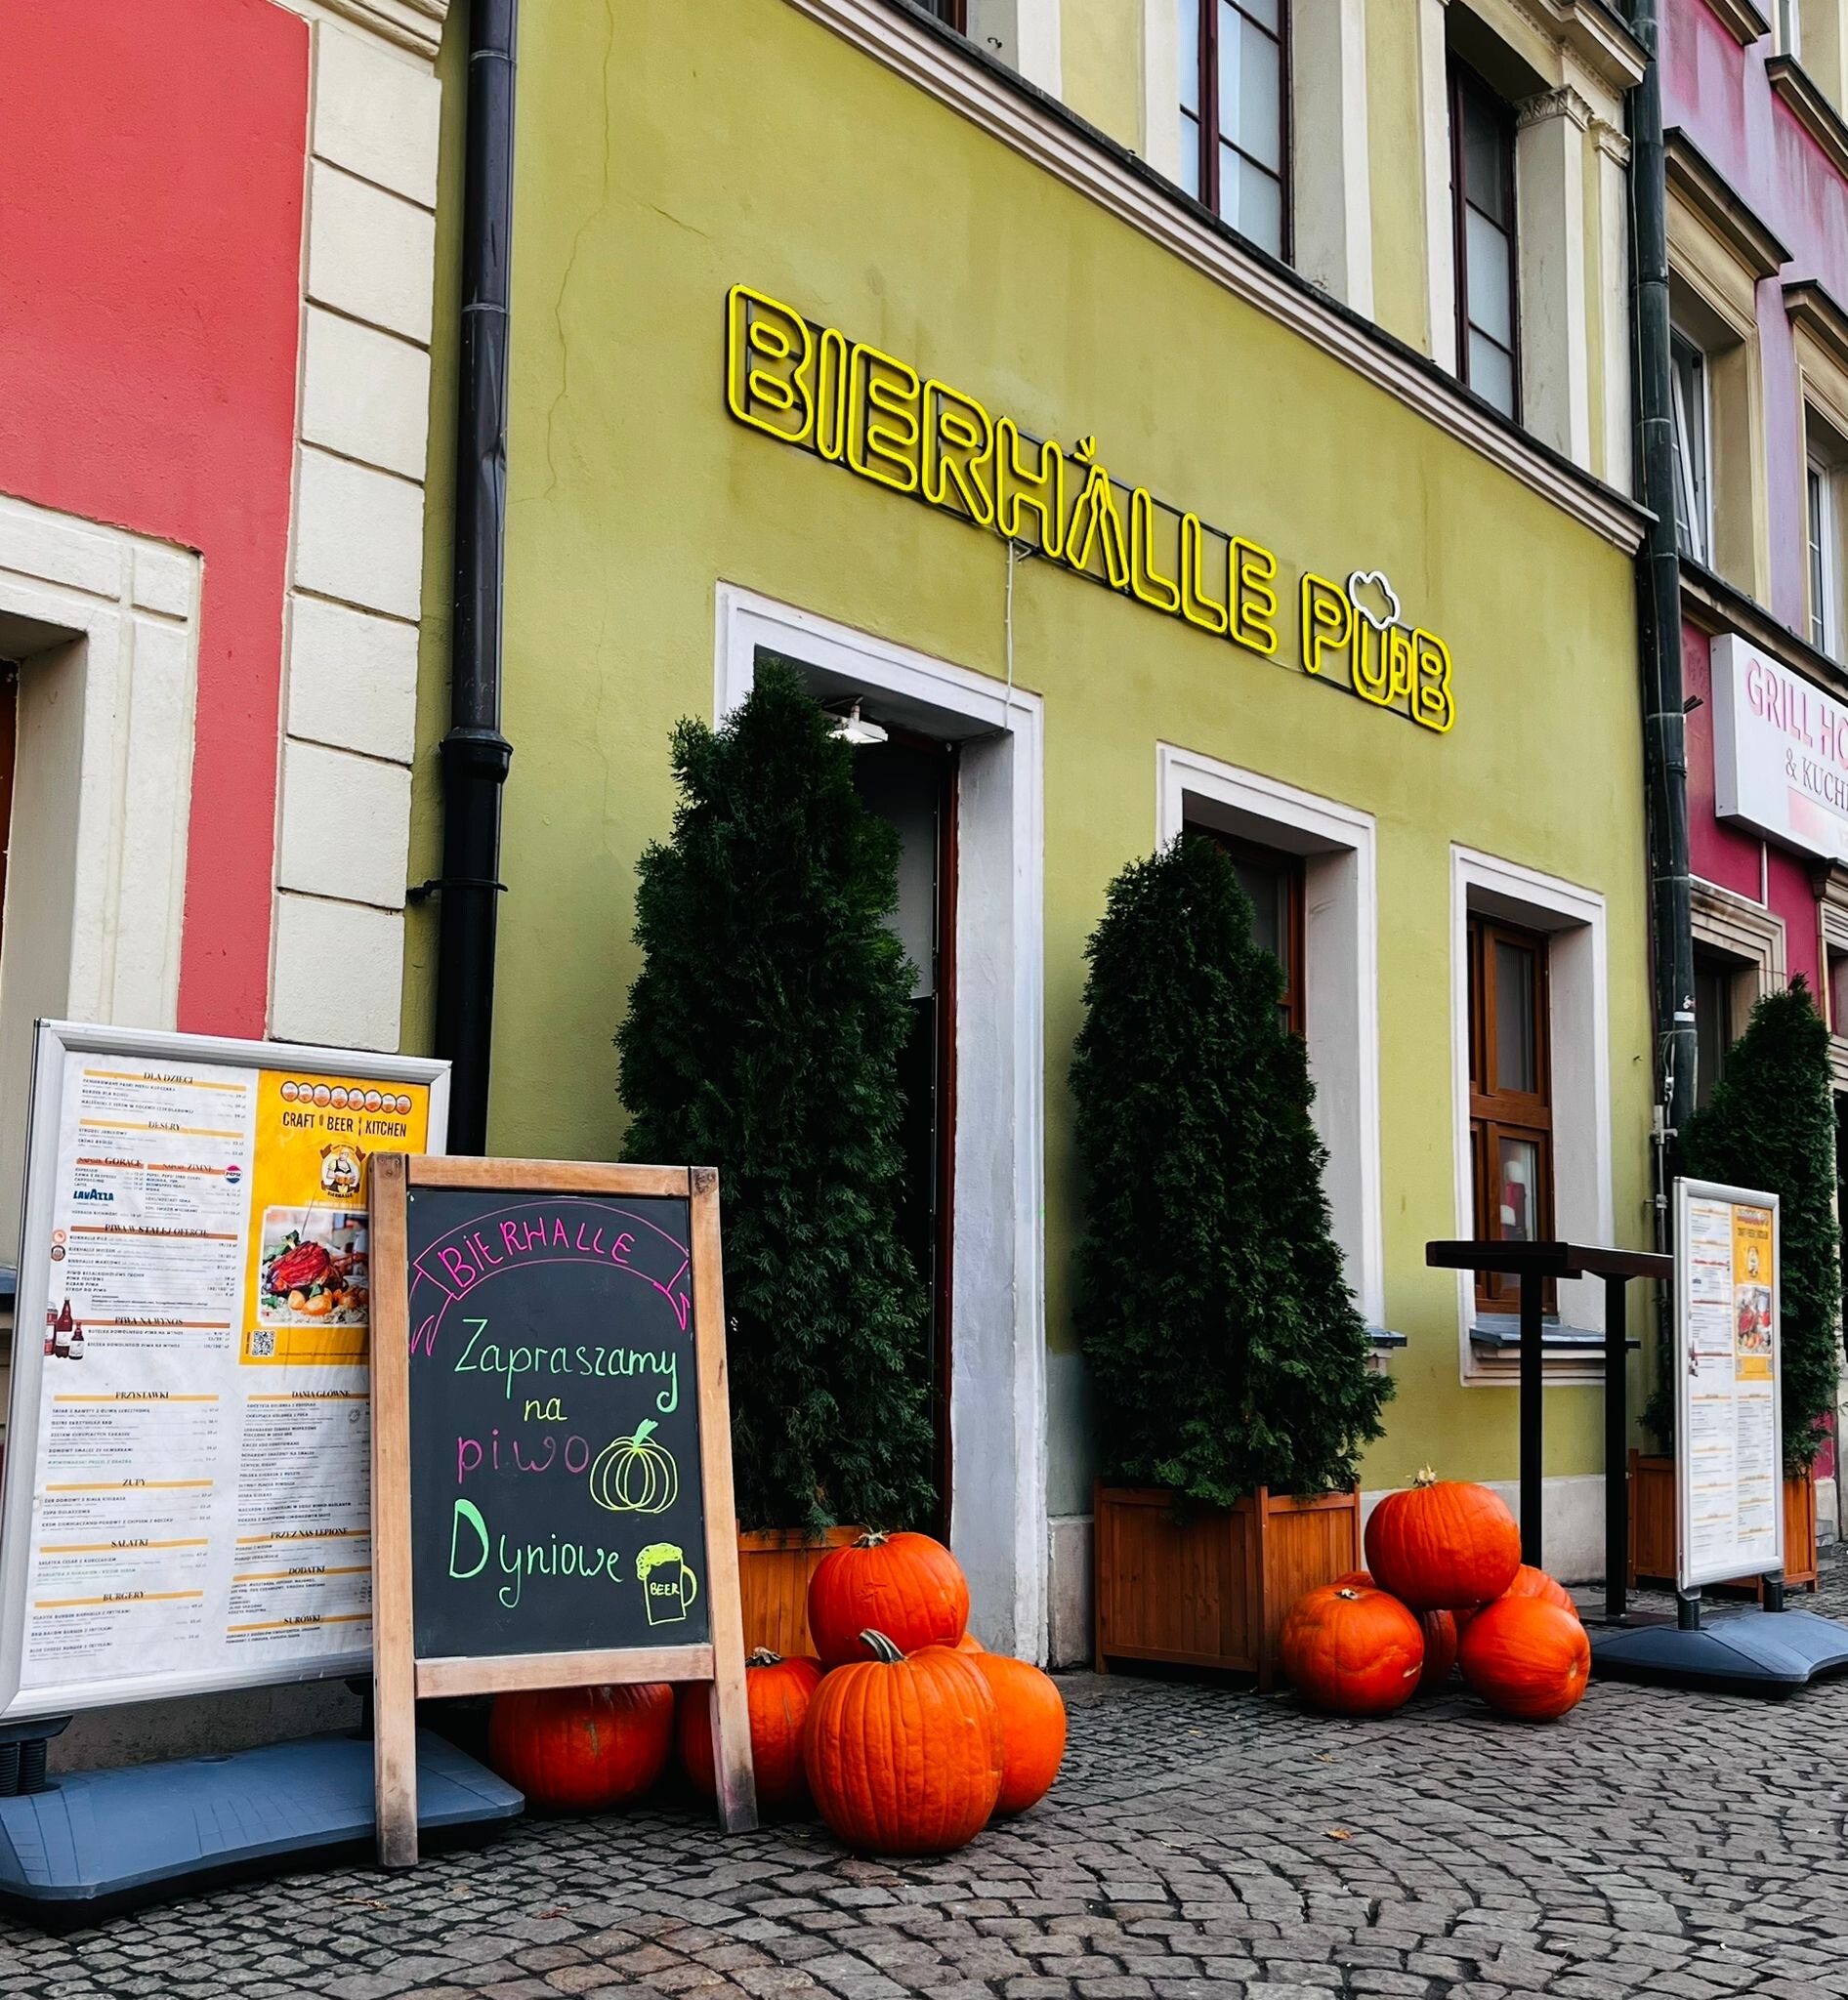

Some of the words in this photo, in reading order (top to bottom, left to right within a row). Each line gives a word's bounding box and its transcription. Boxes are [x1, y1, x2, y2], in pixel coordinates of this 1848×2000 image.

[727, 282, 1278, 655] BIERHALLE
[1300, 570, 1456, 733] PUB
[1745, 657, 1814, 749] GRILL
[1785, 747, 1798, 781] &
[1801, 756, 1848, 812] KUCH
[143, 1072, 161, 1081] DLA
[162, 1074, 194, 1085] DZIECI
[148, 1121, 182, 1132] DESERY
[282, 1111, 315, 1129] CRAFT
[326, 1115, 354, 1133] BEER
[364, 1119, 407, 1138] KITCHEN
[72, 1188, 114, 1201] LAVAZZA
[437, 1216, 636, 1288] BIERHALLE
[114, 1316, 138, 1325] PIWA
[153, 1317, 184, 1326] WYNOS
[453, 1318, 679, 1413] Zapraszamy
[115, 1391, 170, 1399] PRZYSTAWKI
[524, 1397, 568, 1422] na
[456, 1429, 590, 1485] piwo
[122, 1479, 147, 1487] ZUPY
[270, 1530, 298, 1539] PRZEZ
[448, 1498, 624, 1608] Dyniowe
[288, 1565, 326, 1575] DODATKI
[103, 1591, 147, 1602] BURGERY
[649, 1582, 680, 1597] BEER
